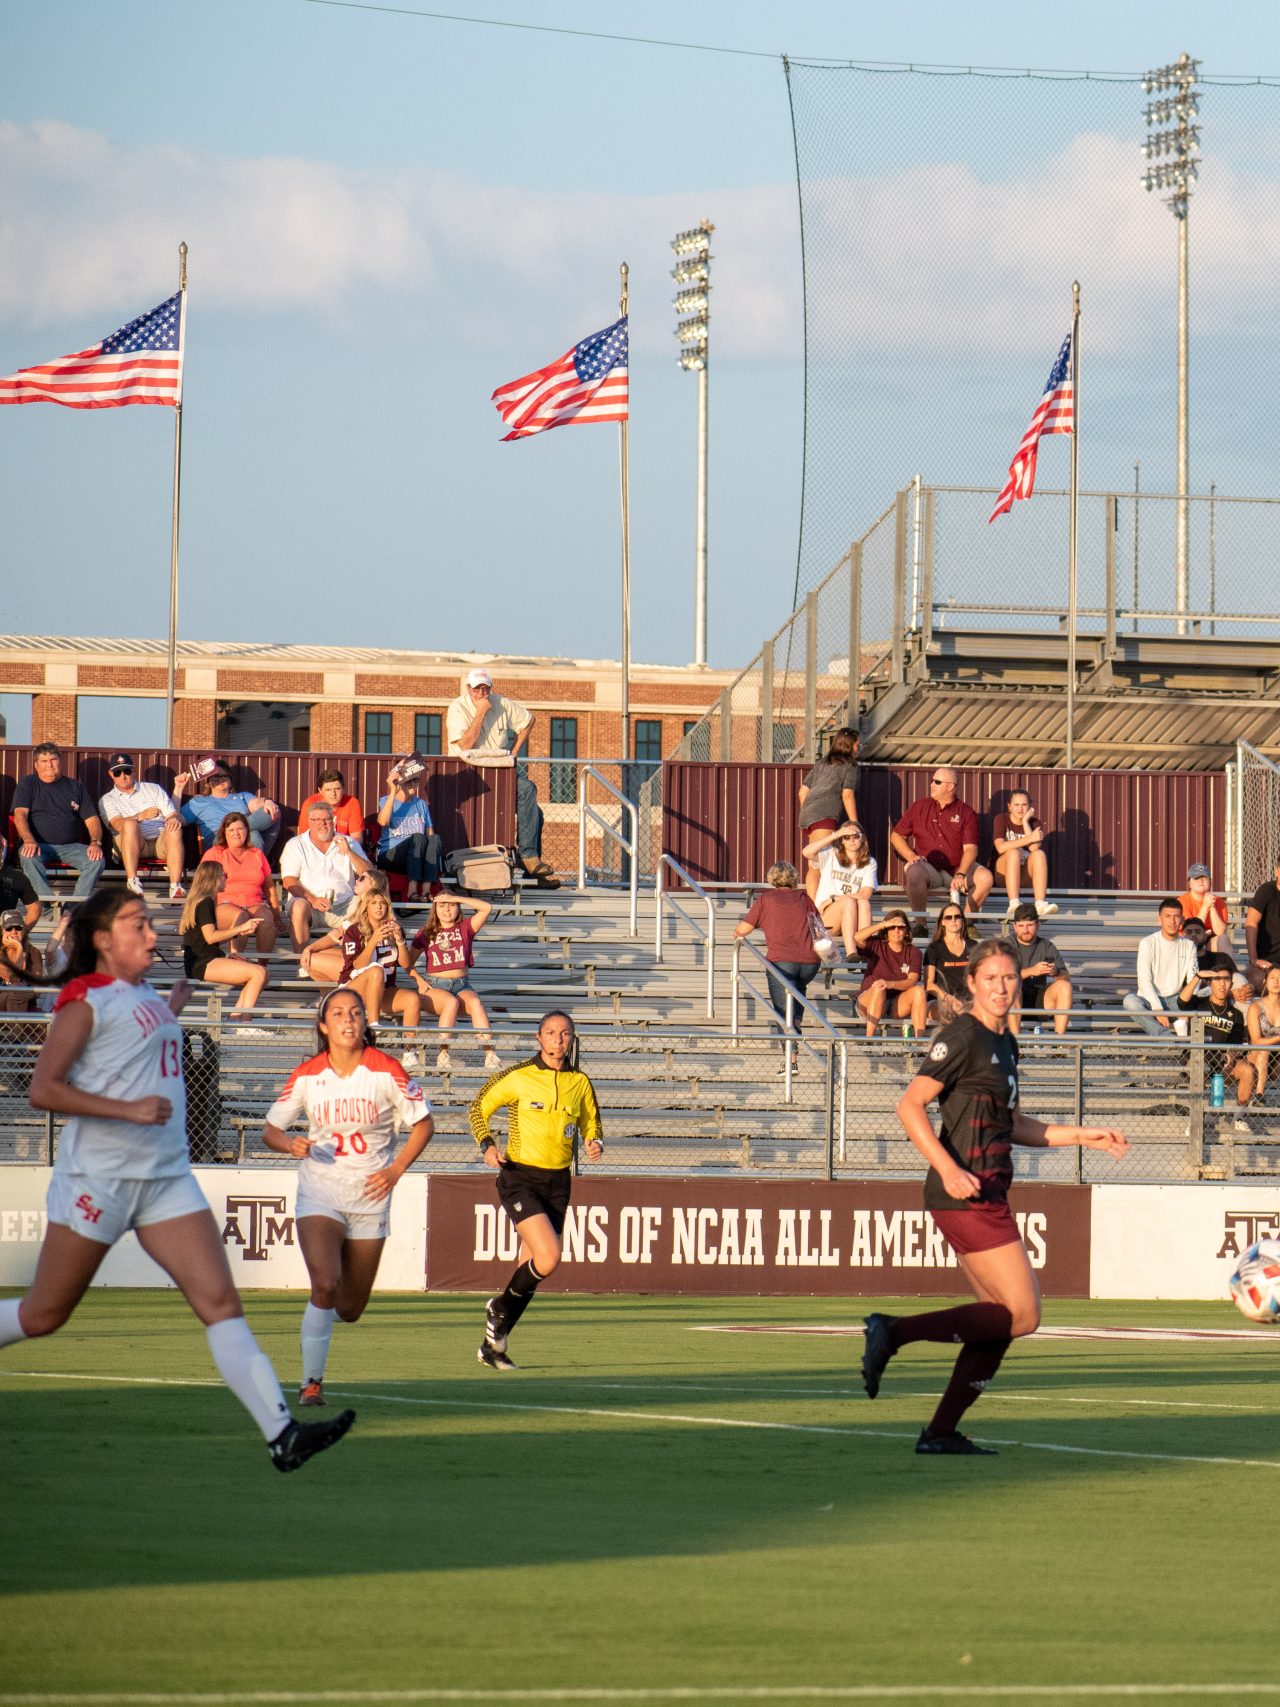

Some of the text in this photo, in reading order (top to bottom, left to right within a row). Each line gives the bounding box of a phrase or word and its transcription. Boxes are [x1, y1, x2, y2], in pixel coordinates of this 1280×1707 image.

[345, 942, 356, 955] 12
[160, 1040, 179, 1078] 13
[312, 1098, 380, 1129] SAM HOUSTON
[331, 1132, 367, 1157] 20
[0, 1211, 47, 1241] EE
[473, 1204, 608, 1263] DONS
[619, 1207, 662, 1263] OF
[671, 1207, 765, 1265] NCAA
[775, 1209, 840, 1266] ALL
